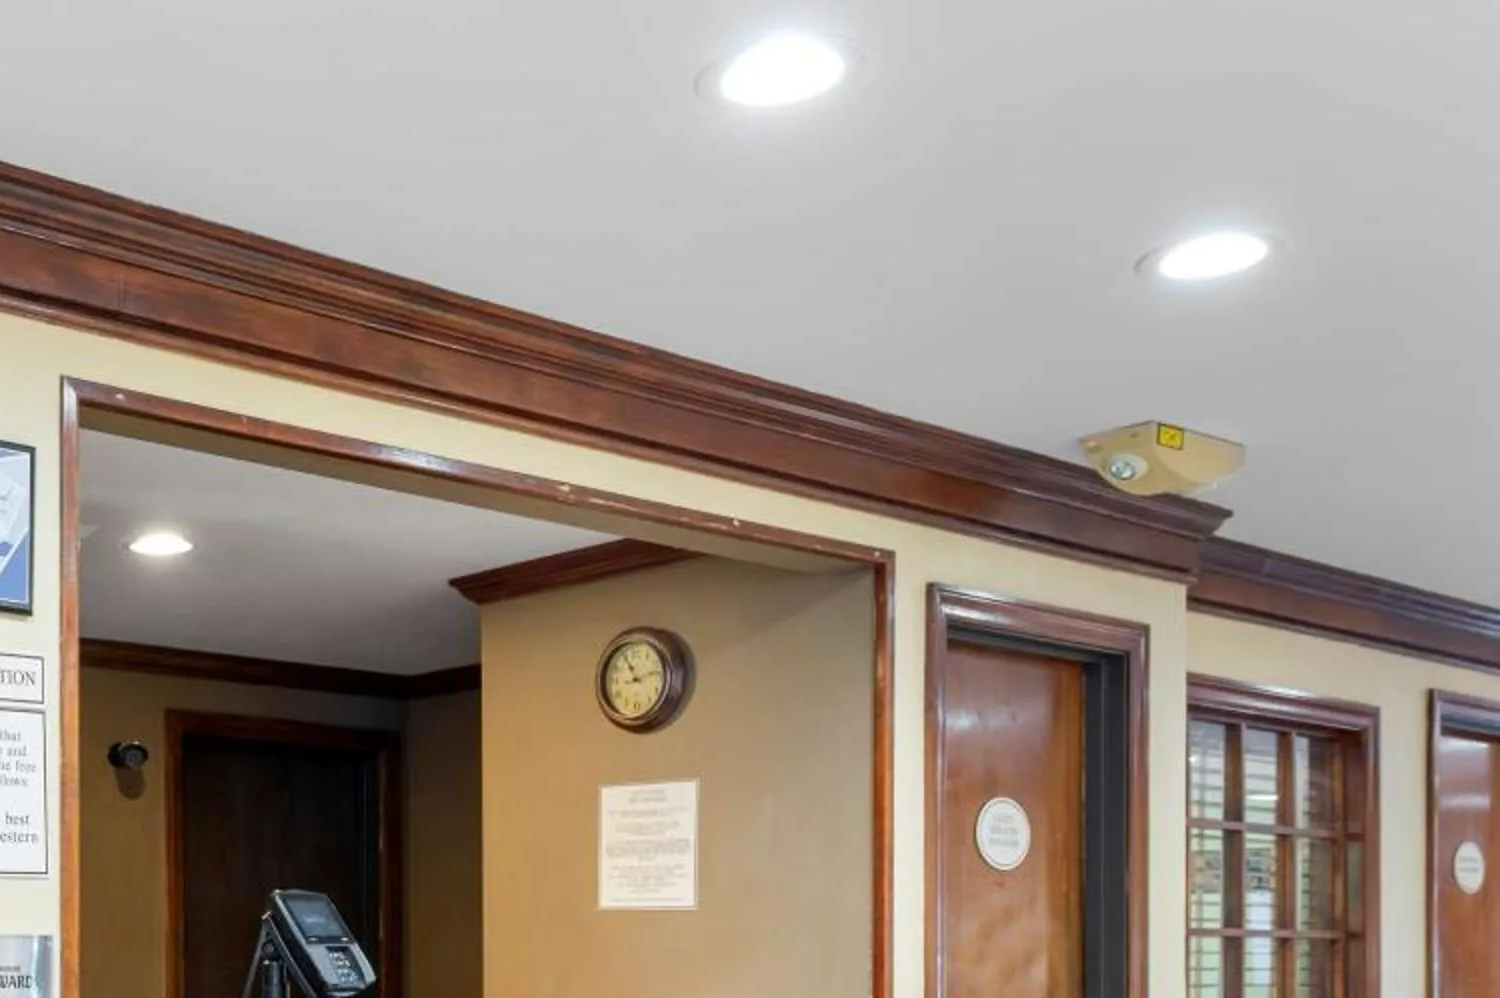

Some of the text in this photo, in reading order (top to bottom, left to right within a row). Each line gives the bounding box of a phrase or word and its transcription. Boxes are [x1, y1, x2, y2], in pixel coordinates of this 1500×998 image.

[0, 729, 21, 741] that
[6, 745, 27, 757] and
[15, 759, 36, 773] free
[5, 811, 30, 826] best
